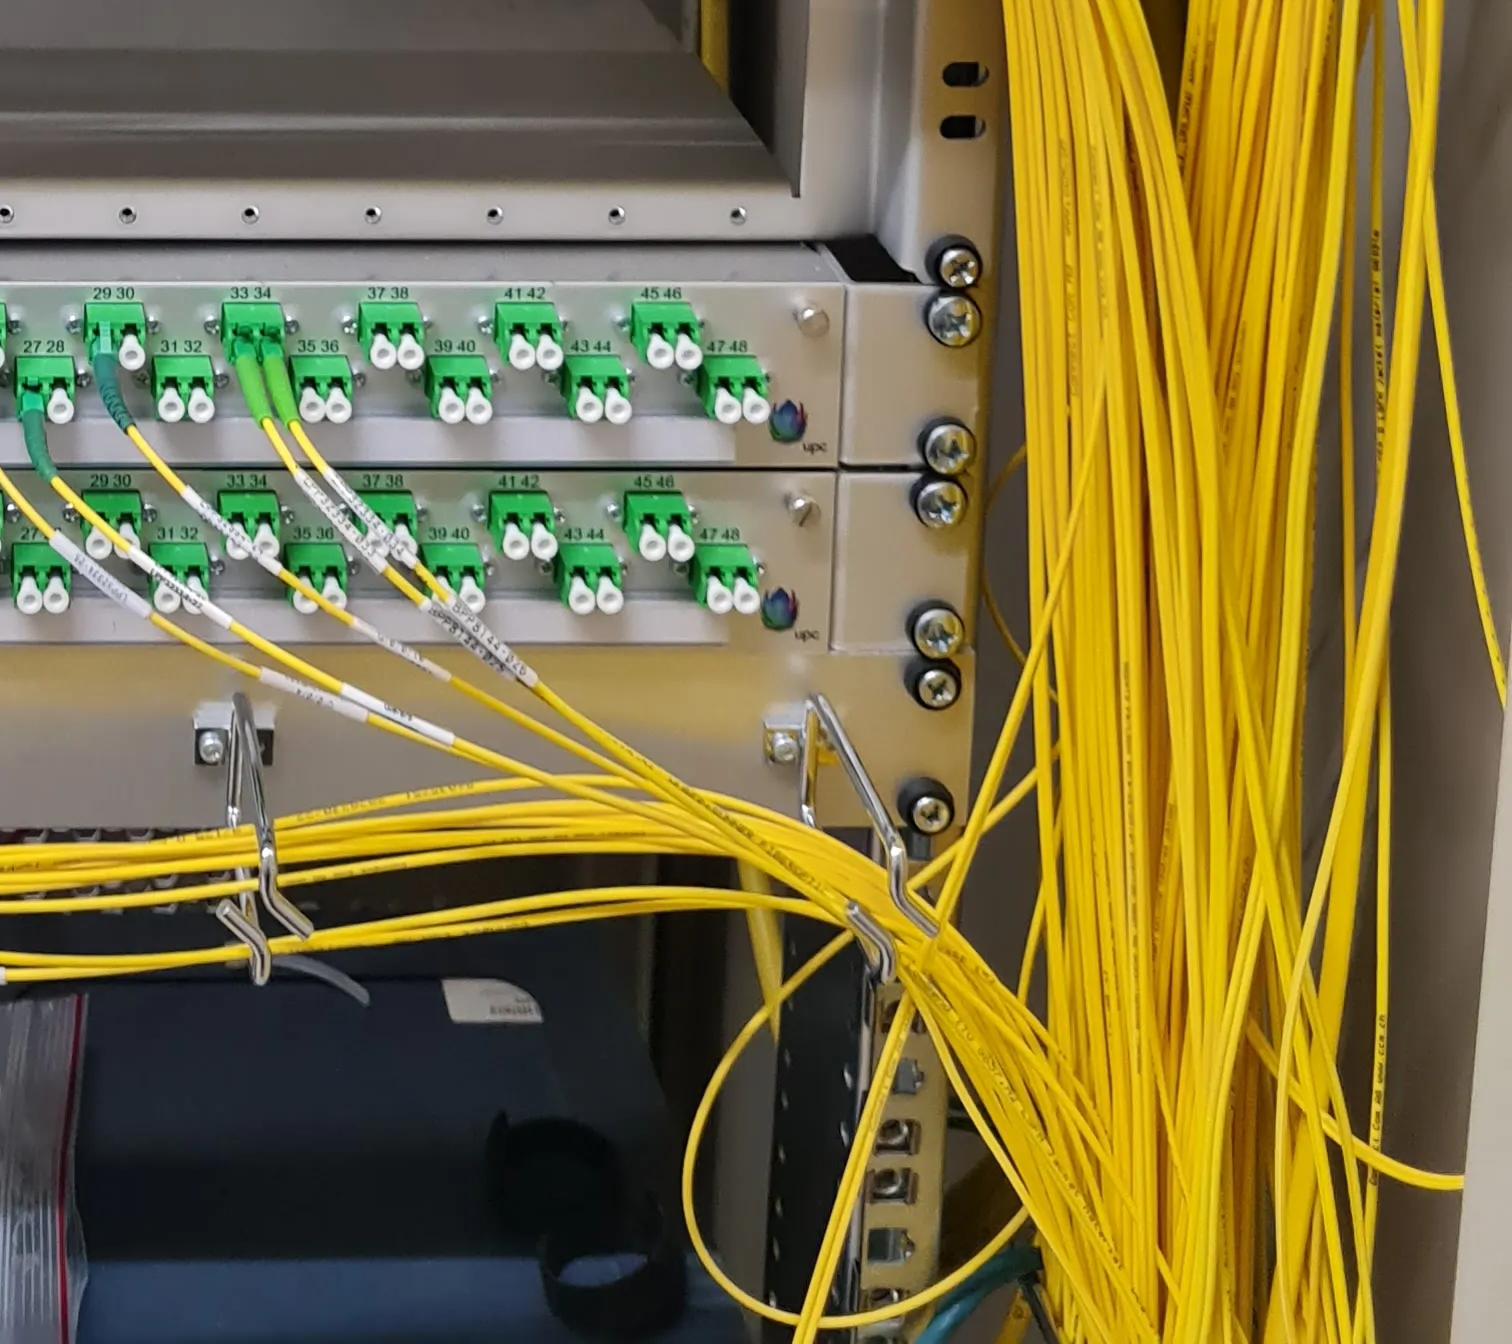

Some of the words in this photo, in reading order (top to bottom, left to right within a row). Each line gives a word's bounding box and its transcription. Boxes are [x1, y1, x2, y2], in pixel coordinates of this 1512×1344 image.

[231, 287, 248, 299] 33
[254, 287, 271, 299] 34
[641, 287, 659, 299] 45
[664, 287, 681, 299] 46
[803, 443, 826, 455] upc
[795, 630, 818, 642] upc
